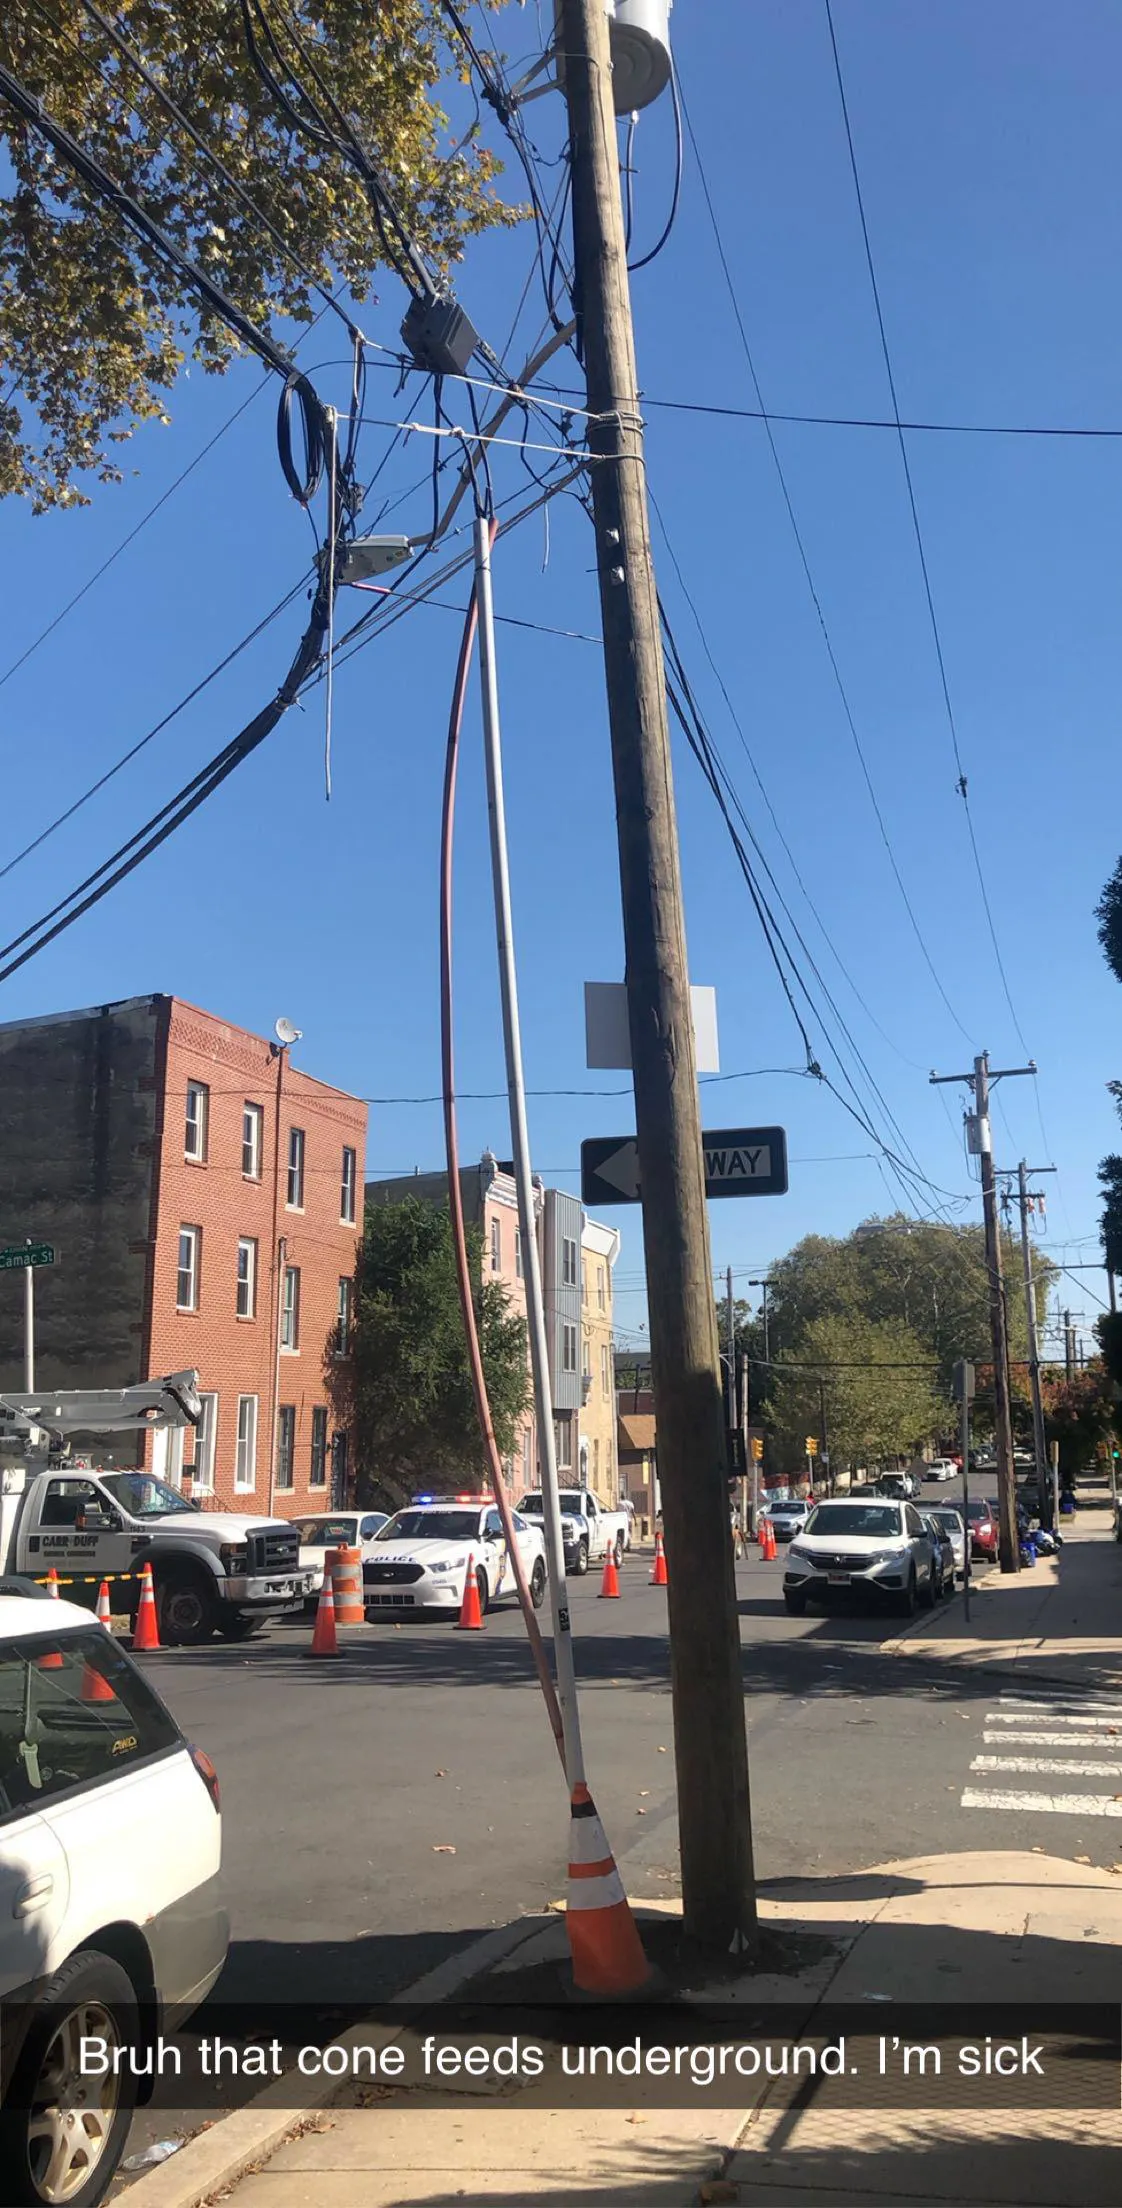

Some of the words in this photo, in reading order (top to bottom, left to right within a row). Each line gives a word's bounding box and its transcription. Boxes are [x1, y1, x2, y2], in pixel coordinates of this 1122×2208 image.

[706, 1149, 762, 1176] WAY
[41, 1251, 53, 1263] St
[365, 1556, 416, 1564] POLICE
